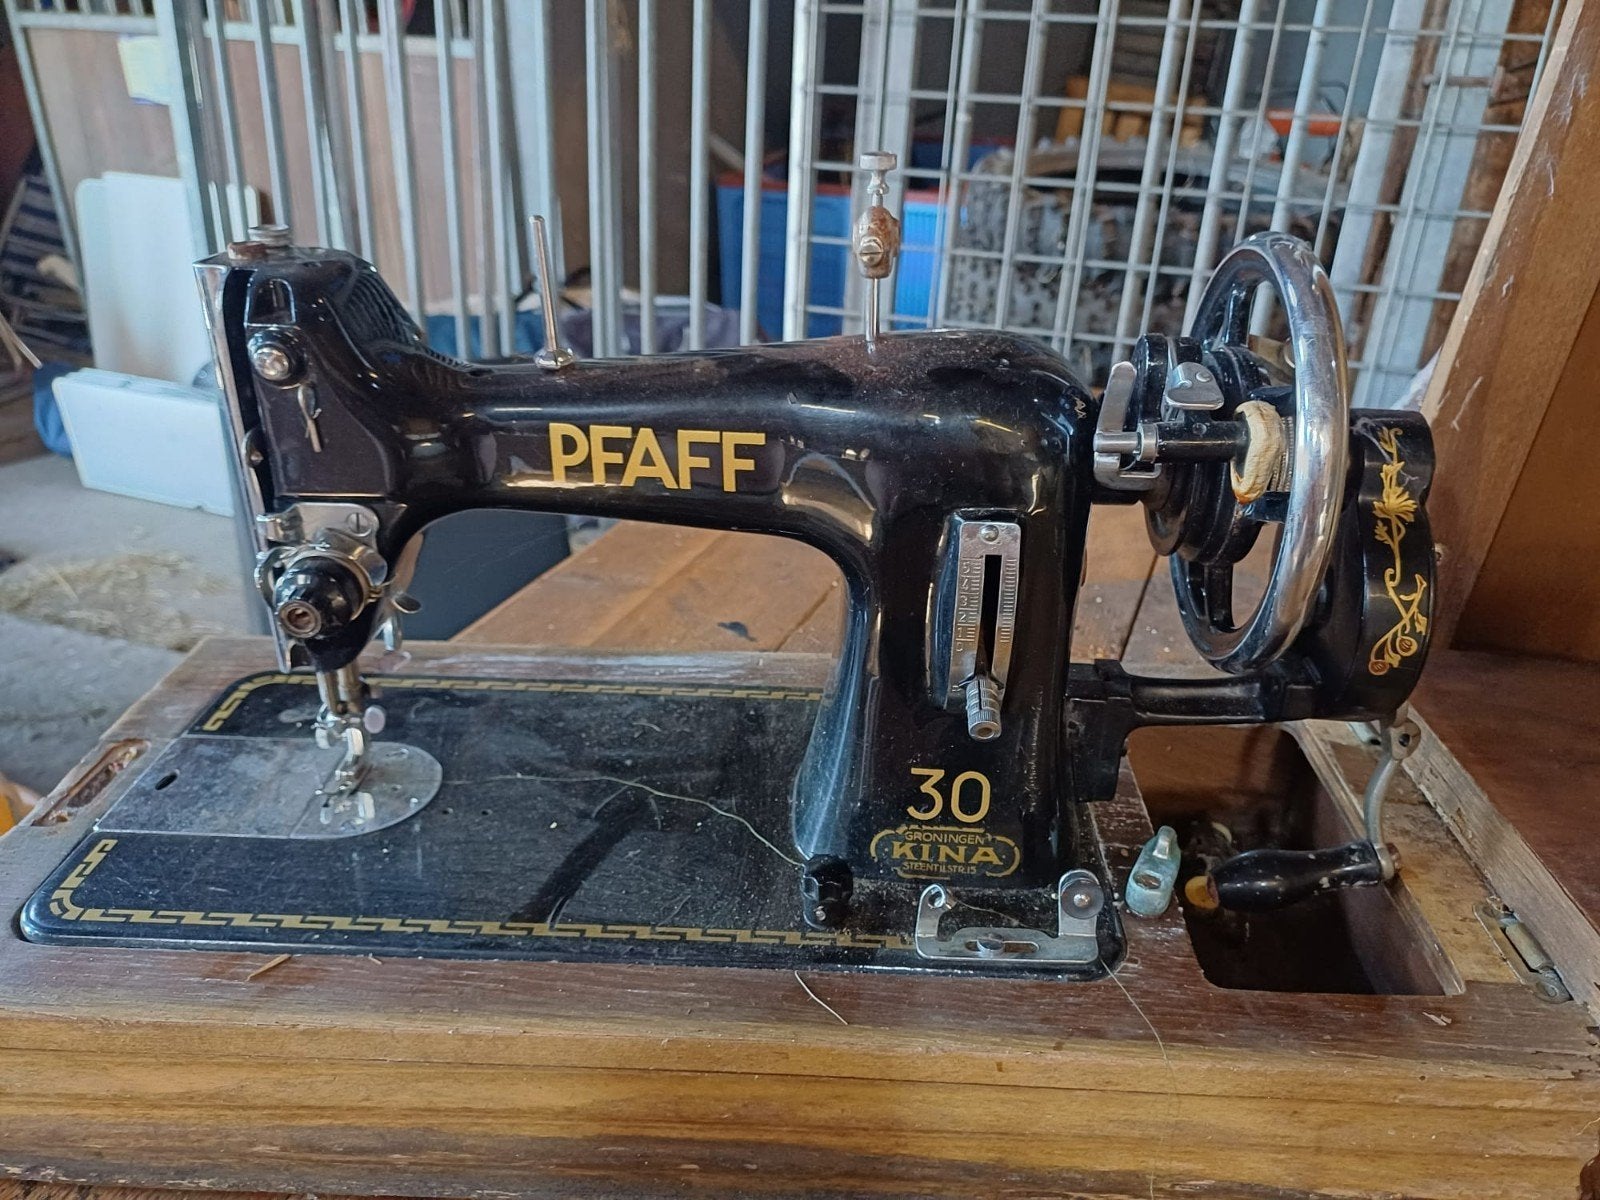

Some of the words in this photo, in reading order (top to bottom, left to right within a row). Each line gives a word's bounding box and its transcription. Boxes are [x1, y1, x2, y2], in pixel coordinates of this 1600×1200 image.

[549, 423, 766, 492] PFAFF
[906, 767, 991, 823] 30
[891, 841, 1004, 866] KINA
[905, 831, 985, 845] GRONINGEN
